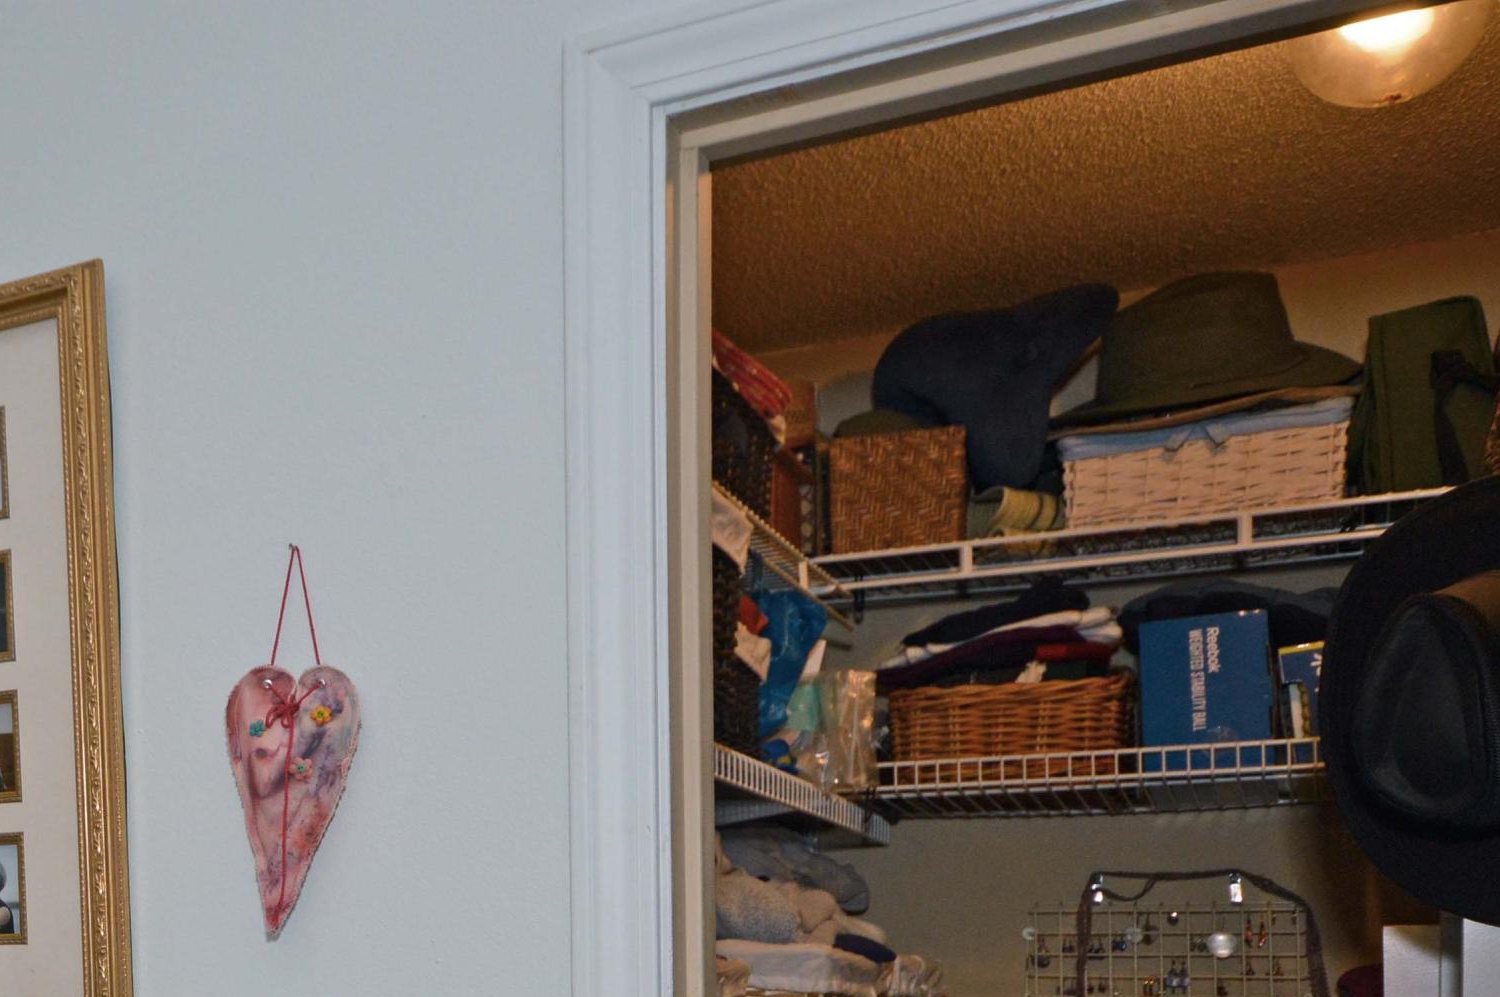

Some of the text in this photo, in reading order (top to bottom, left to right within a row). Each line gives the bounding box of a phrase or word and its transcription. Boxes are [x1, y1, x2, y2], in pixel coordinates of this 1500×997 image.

[1188, 628, 1207, 732] WEIGHTED STABILITY BALL
[1206, 626, 1221, 673] Reebok
